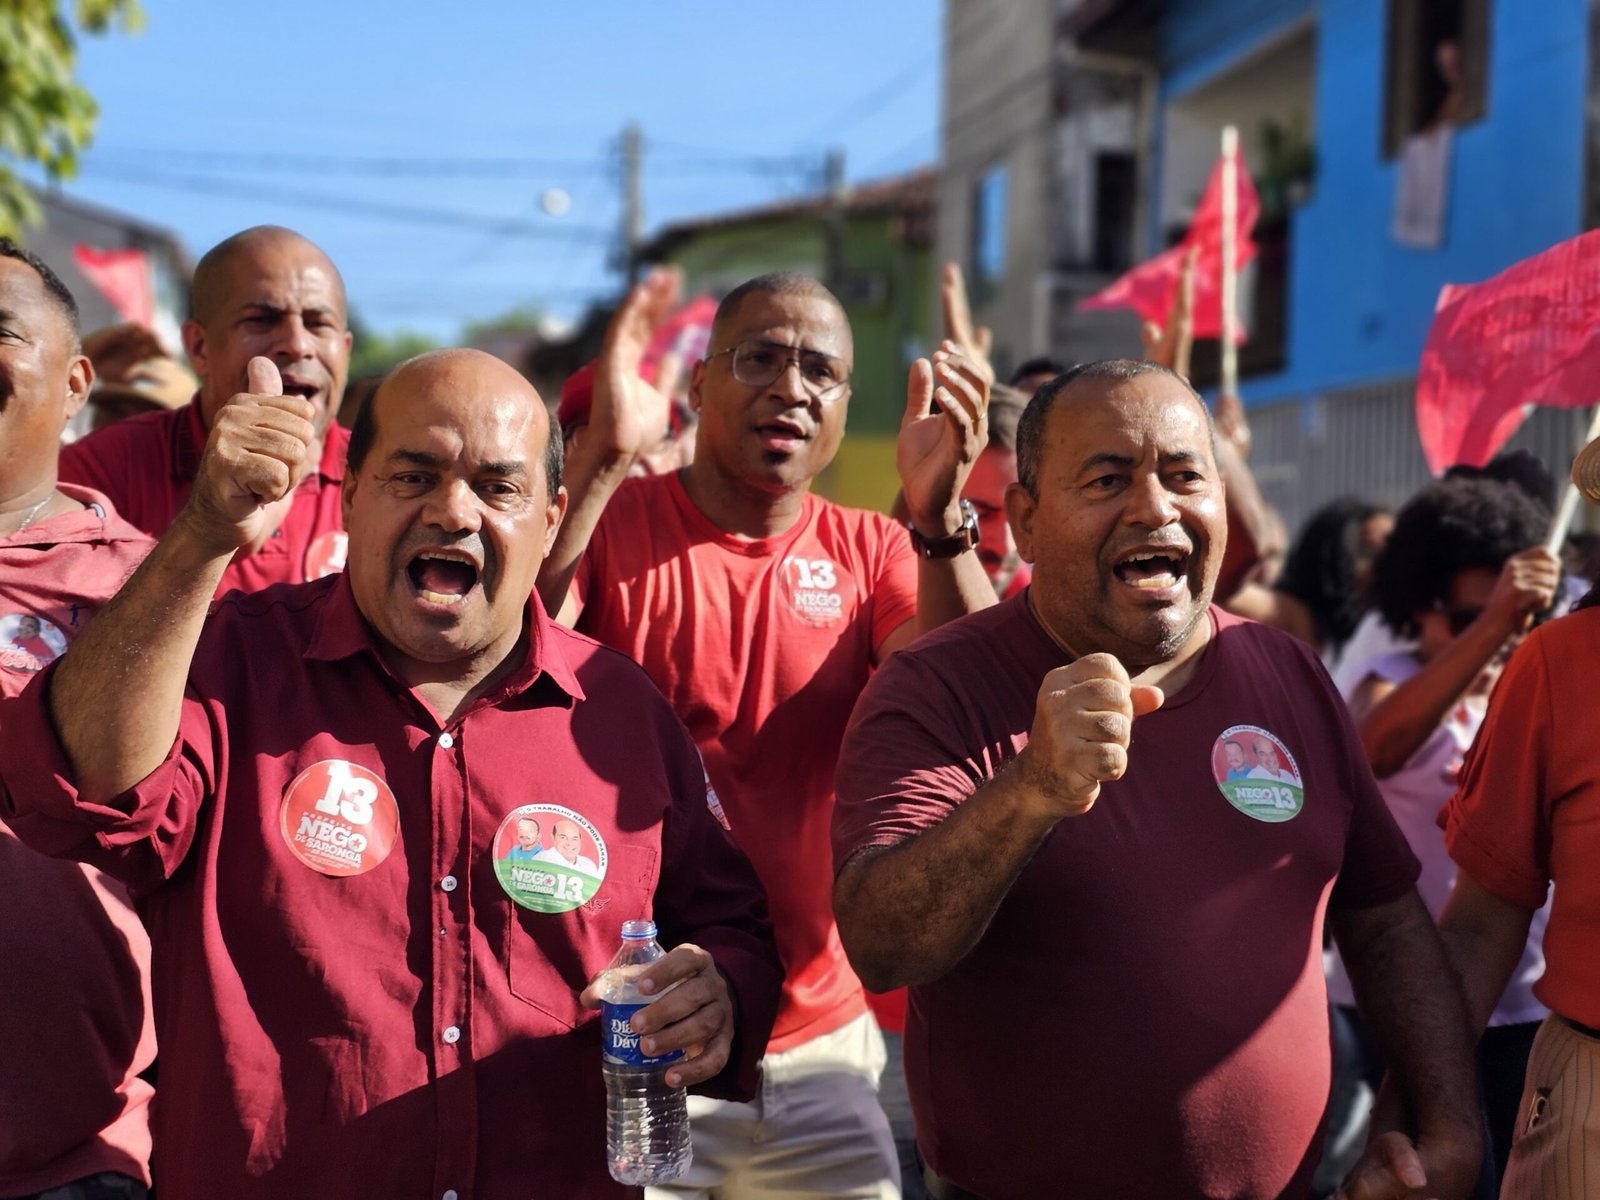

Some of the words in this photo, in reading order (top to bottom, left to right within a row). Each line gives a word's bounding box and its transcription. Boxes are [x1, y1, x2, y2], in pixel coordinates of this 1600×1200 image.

[794, 558, 837, 590] 13
[794, 592, 842, 607] NEGO
[314, 760, 379, 825] 13
[1234, 787, 1273, 800] NEGO
[1271, 786, 1296, 809] 13
[533, 806, 572, 817] TRABALHO
[573, 814, 587, 826] NÃO
[297, 816, 368, 854] NEGO
[305, 838, 362, 865] SARONGA
[511, 868, 556, 887] NEGO
[554, 873, 584, 902] 13
